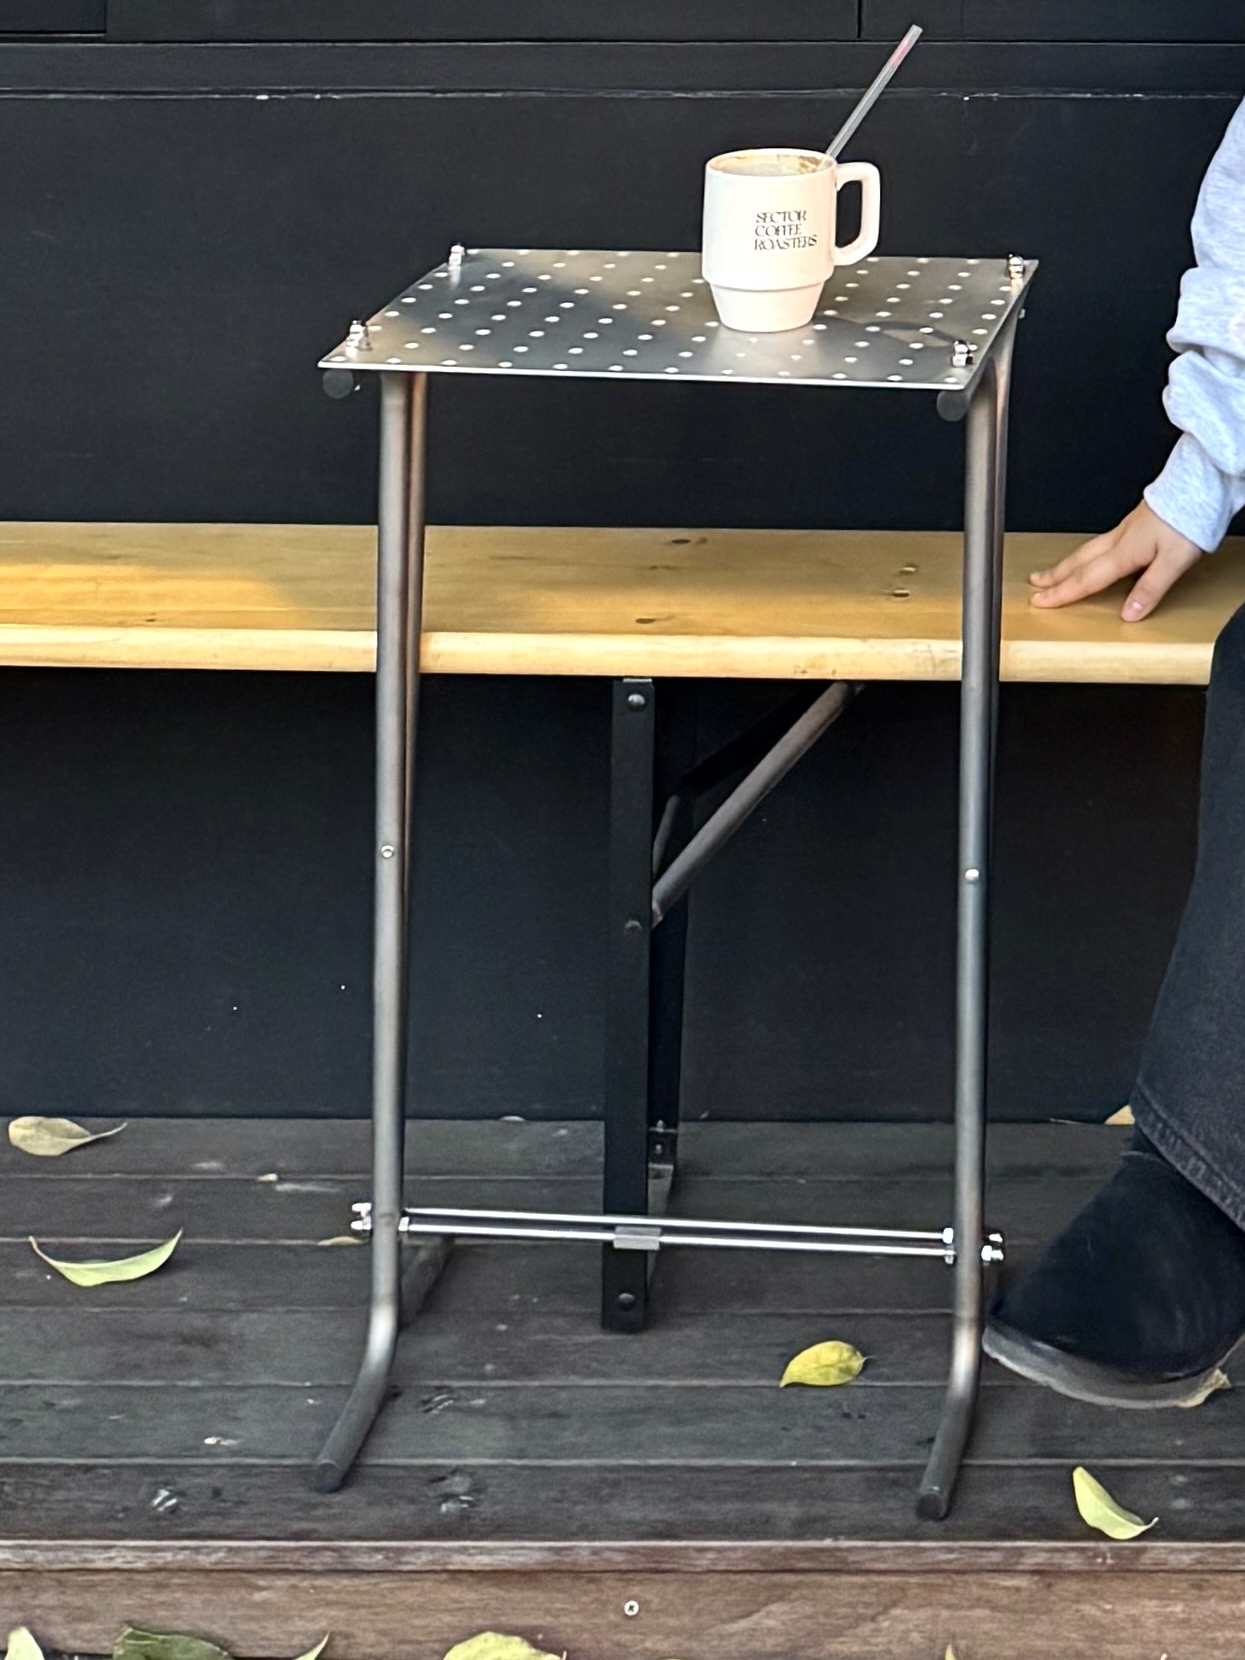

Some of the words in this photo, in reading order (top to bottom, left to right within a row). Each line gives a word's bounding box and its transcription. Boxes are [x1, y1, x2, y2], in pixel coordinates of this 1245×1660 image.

[755, 210, 807, 223] SECTOR
[755, 223, 802, 236] COFFEE
[754, 234, 817, 250] ROASTERS
